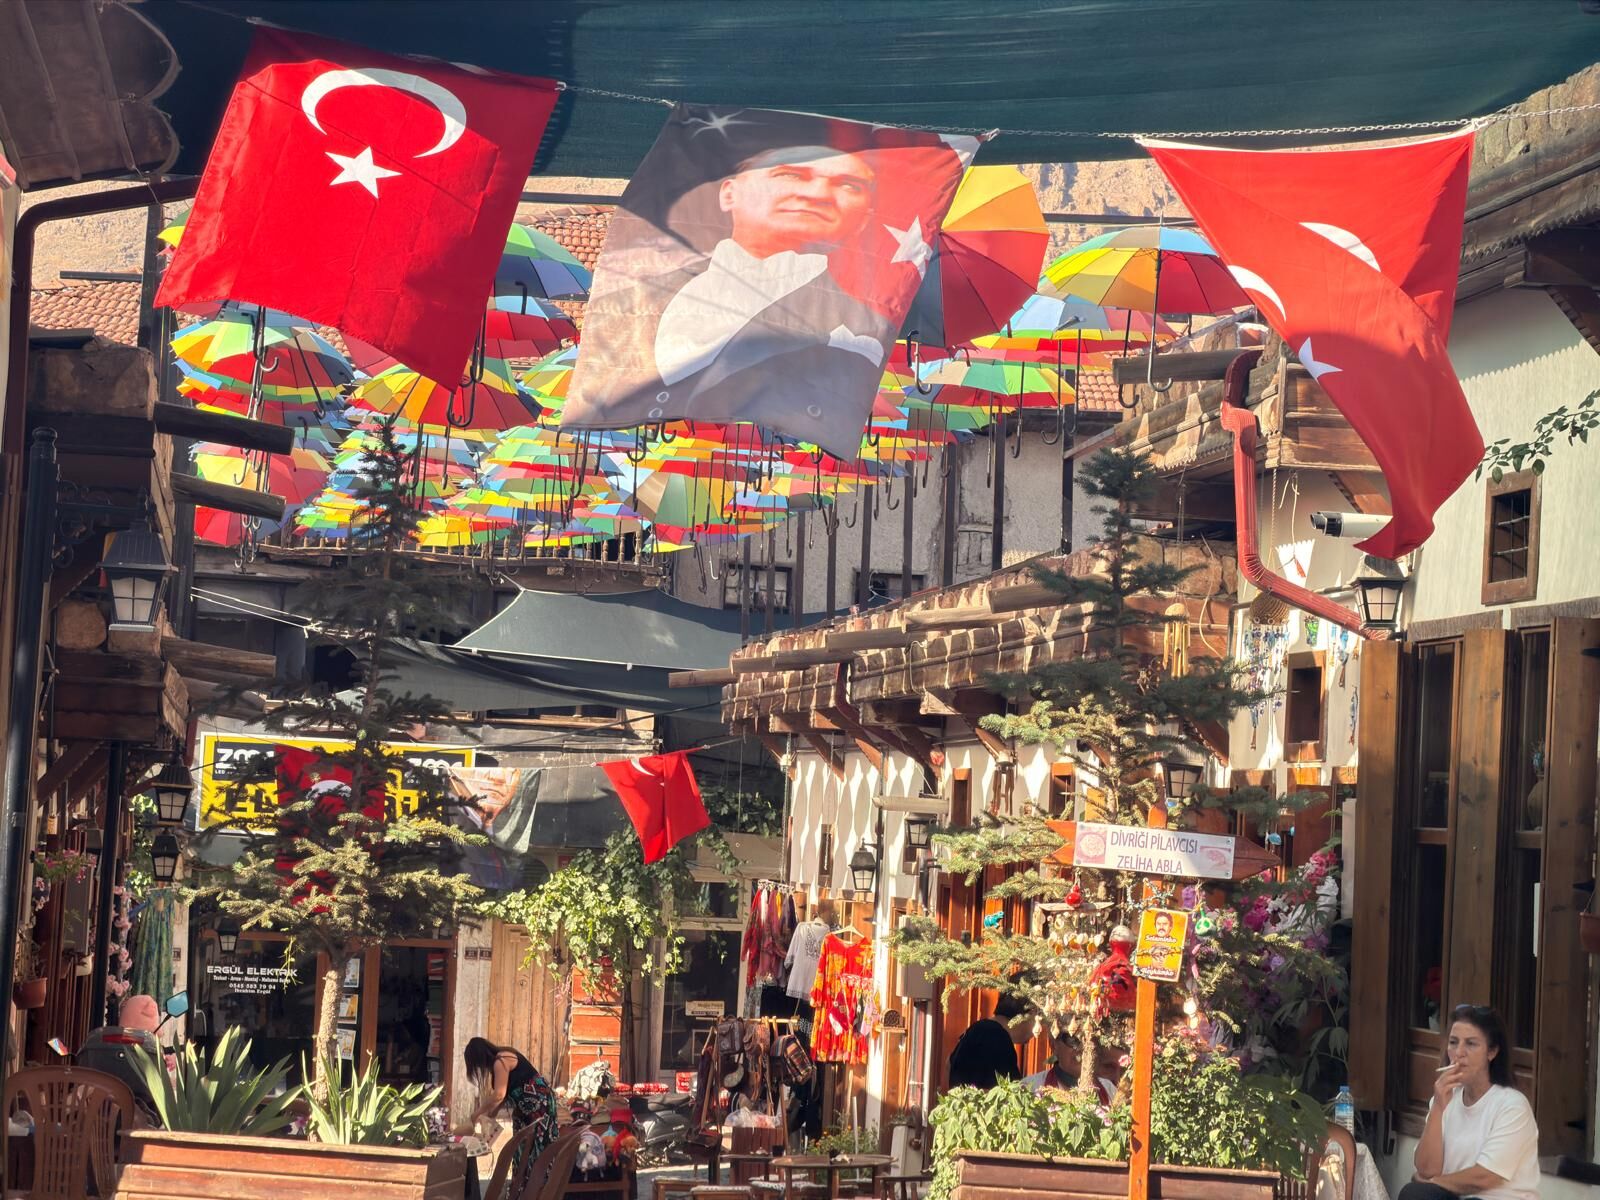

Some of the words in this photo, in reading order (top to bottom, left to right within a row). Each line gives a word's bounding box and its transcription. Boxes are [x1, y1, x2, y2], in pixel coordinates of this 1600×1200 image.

[1110, 829, 1149, 849] DİVRİĞİ
[1150, 832, 1198, 854] PİLAVCISI
[1117, 854, 1153, 872] ZELİHA
[1155, 859, 1183, 874] ABLA
[206, 964, 244, 975] ERGÜL
